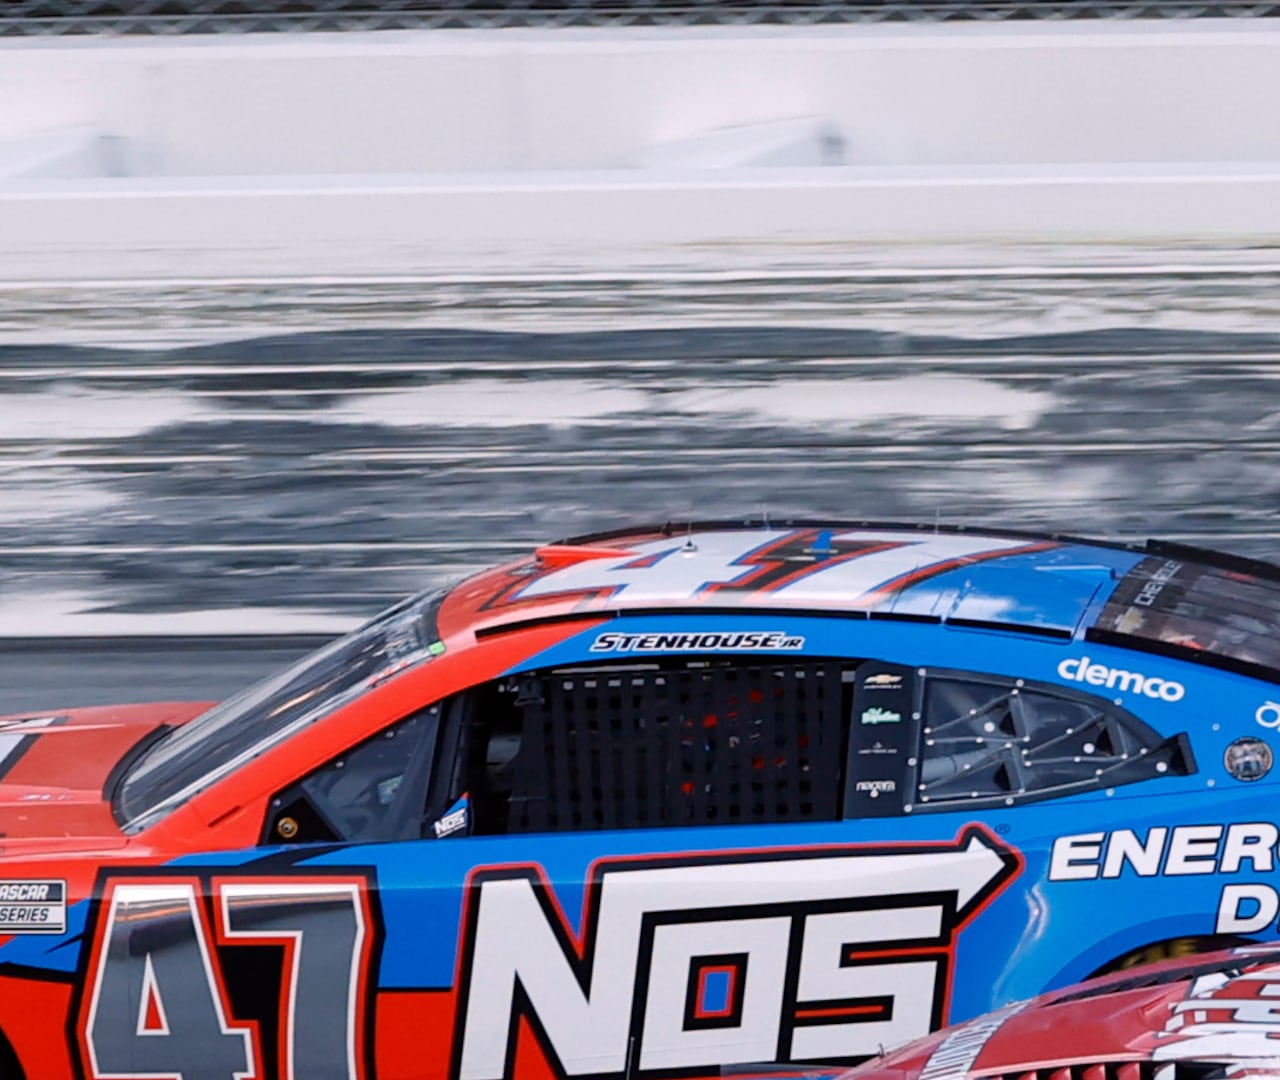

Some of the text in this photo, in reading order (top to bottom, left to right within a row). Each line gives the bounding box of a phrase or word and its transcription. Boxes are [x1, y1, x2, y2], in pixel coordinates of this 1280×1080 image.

[514, 528, 1045, 602] 47
[593, 633, 784, 650] STENHOUSE
[1058, 657, 1184, 701] clemco
